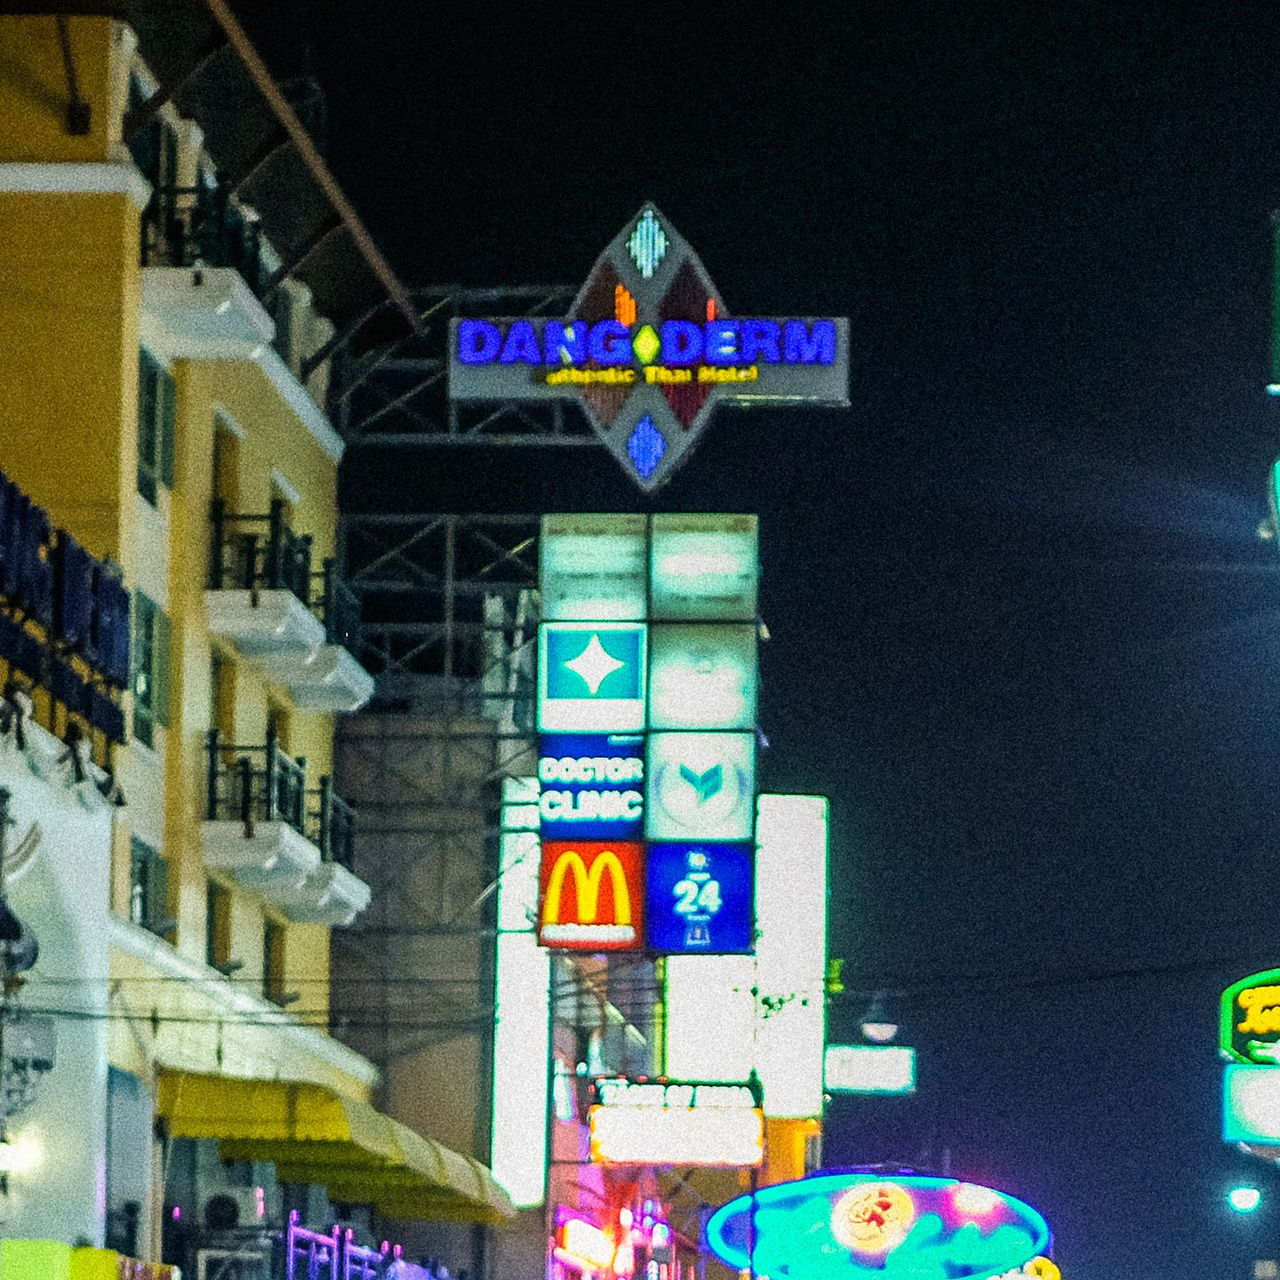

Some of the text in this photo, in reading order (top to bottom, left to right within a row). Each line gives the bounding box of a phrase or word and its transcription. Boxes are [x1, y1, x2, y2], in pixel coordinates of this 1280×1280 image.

[457, 319, 836, 365] DANG DERM
[538, 757, 644, 782] DOCTOR
[539, 790, 644, 822] CLINIC
[673, 878, 723, 914] 24
